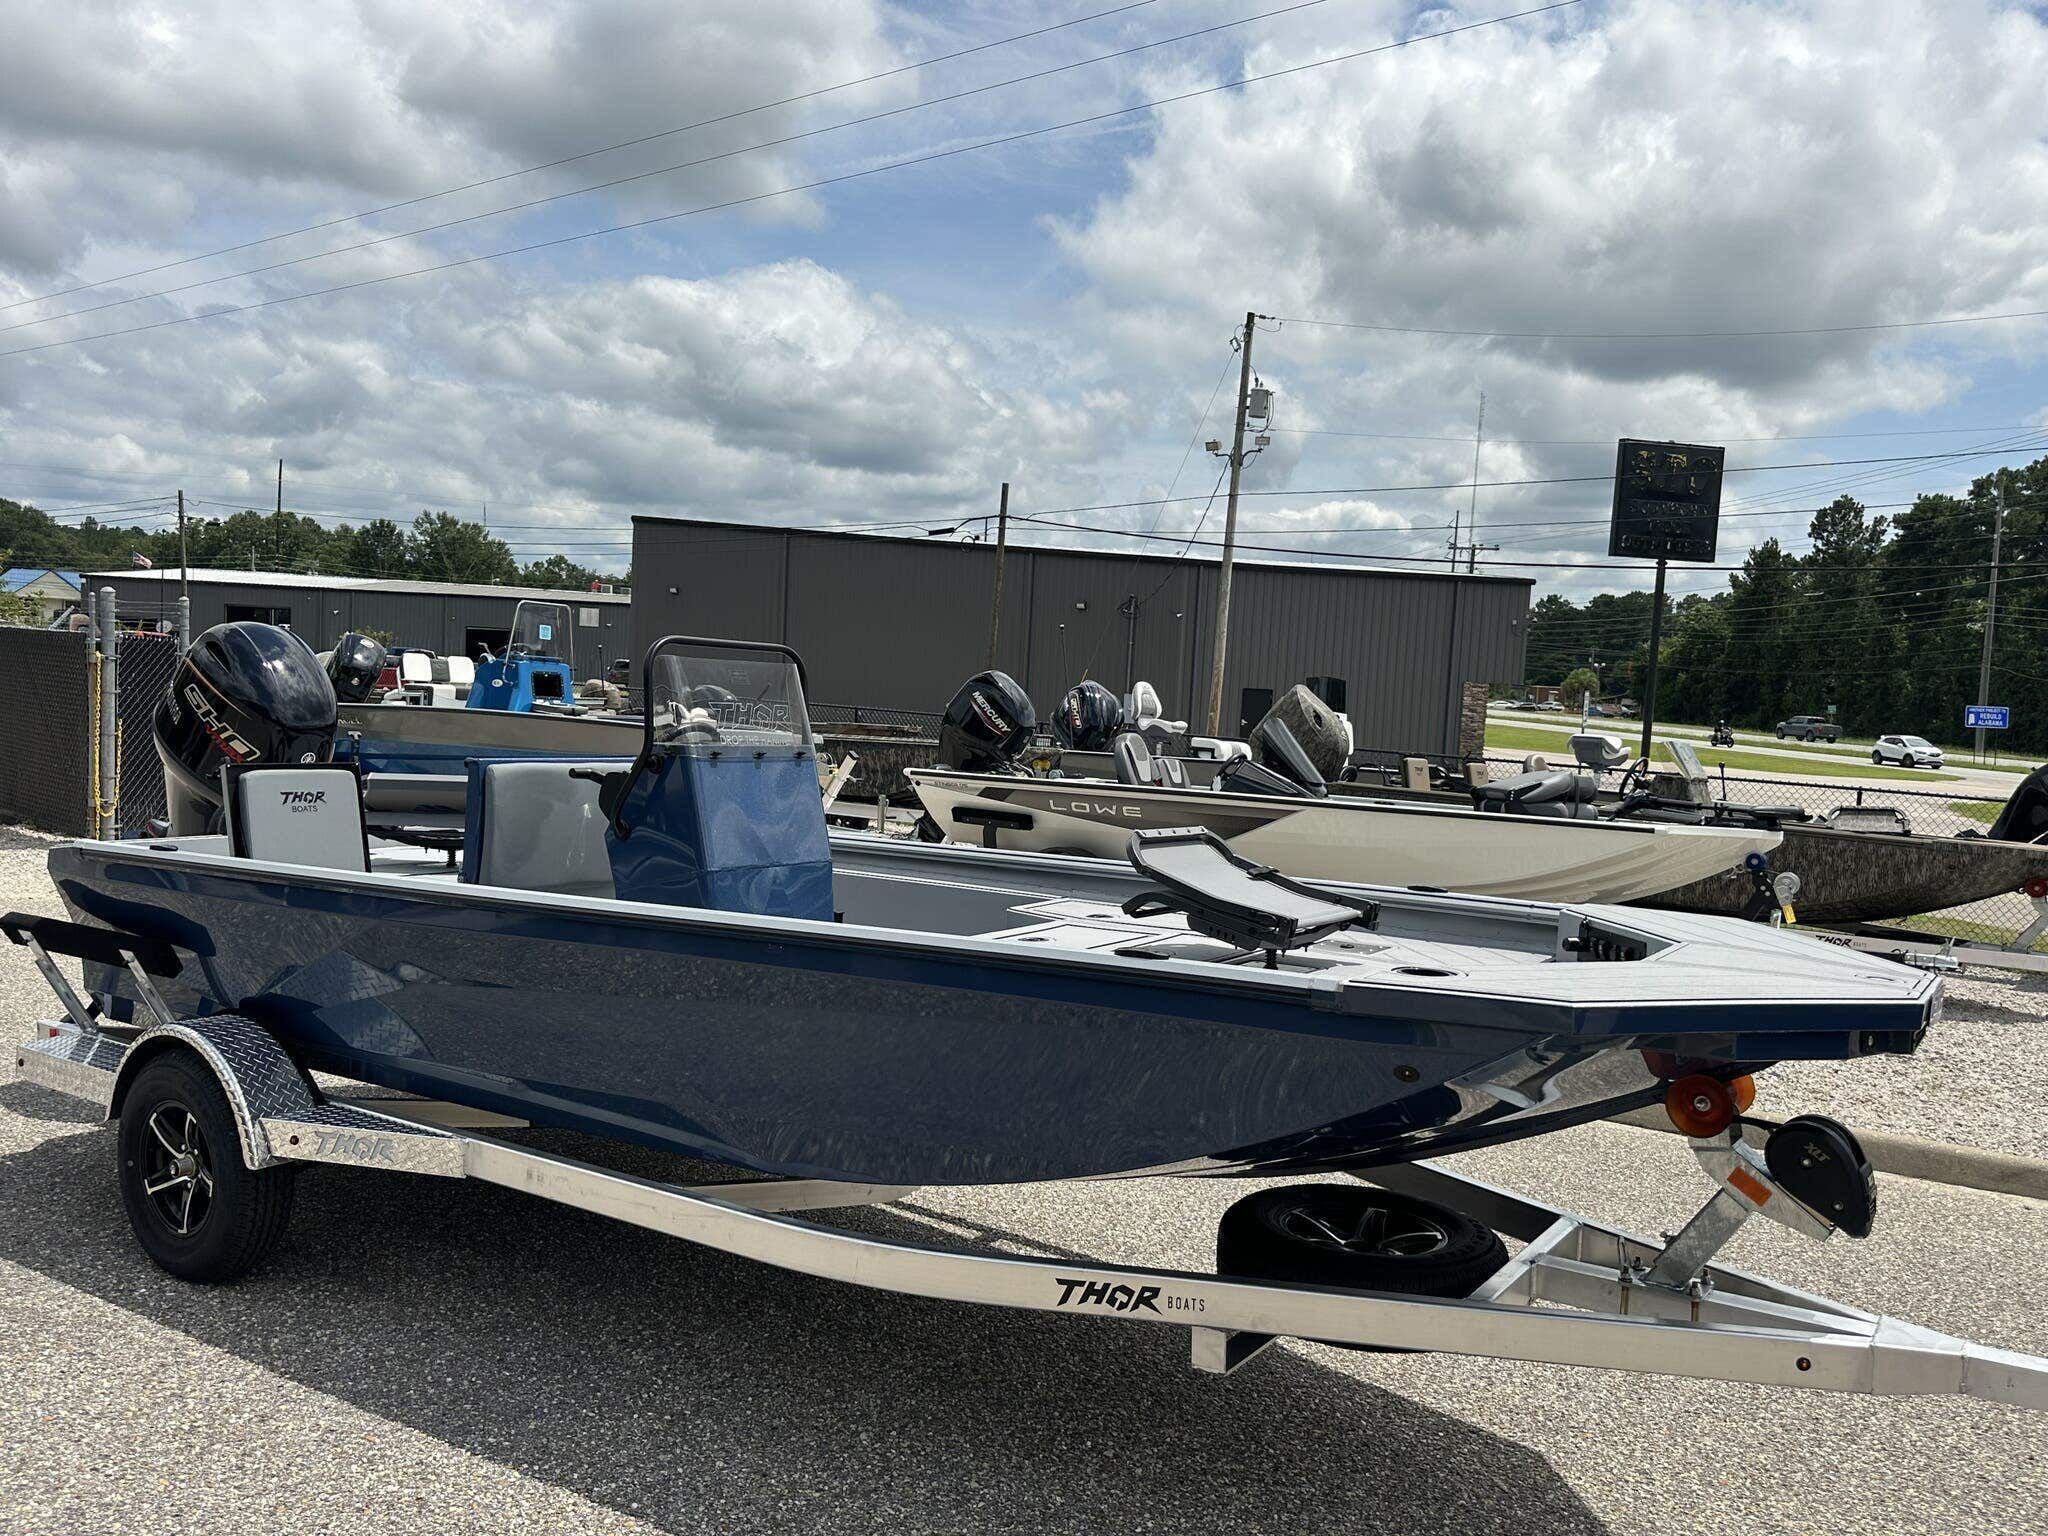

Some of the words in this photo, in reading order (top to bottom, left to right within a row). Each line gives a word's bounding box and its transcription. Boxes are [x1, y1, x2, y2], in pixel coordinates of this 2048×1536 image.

[184, 683, 260, 761] SHO
[709, 701, 793, 732] THOR
[972, 690, 1012, 733] MERCURY
[280, 791, 327, 805] THOR
[1049, 799, 1142, 818] LOWE
[1815, 935, 1853, 948] THOR
[315, 1130, 395, 1163] THOR
[1055, 1278, 1164, 1315] THOR
[1167, 1296, 1205, 1312] BOATS
